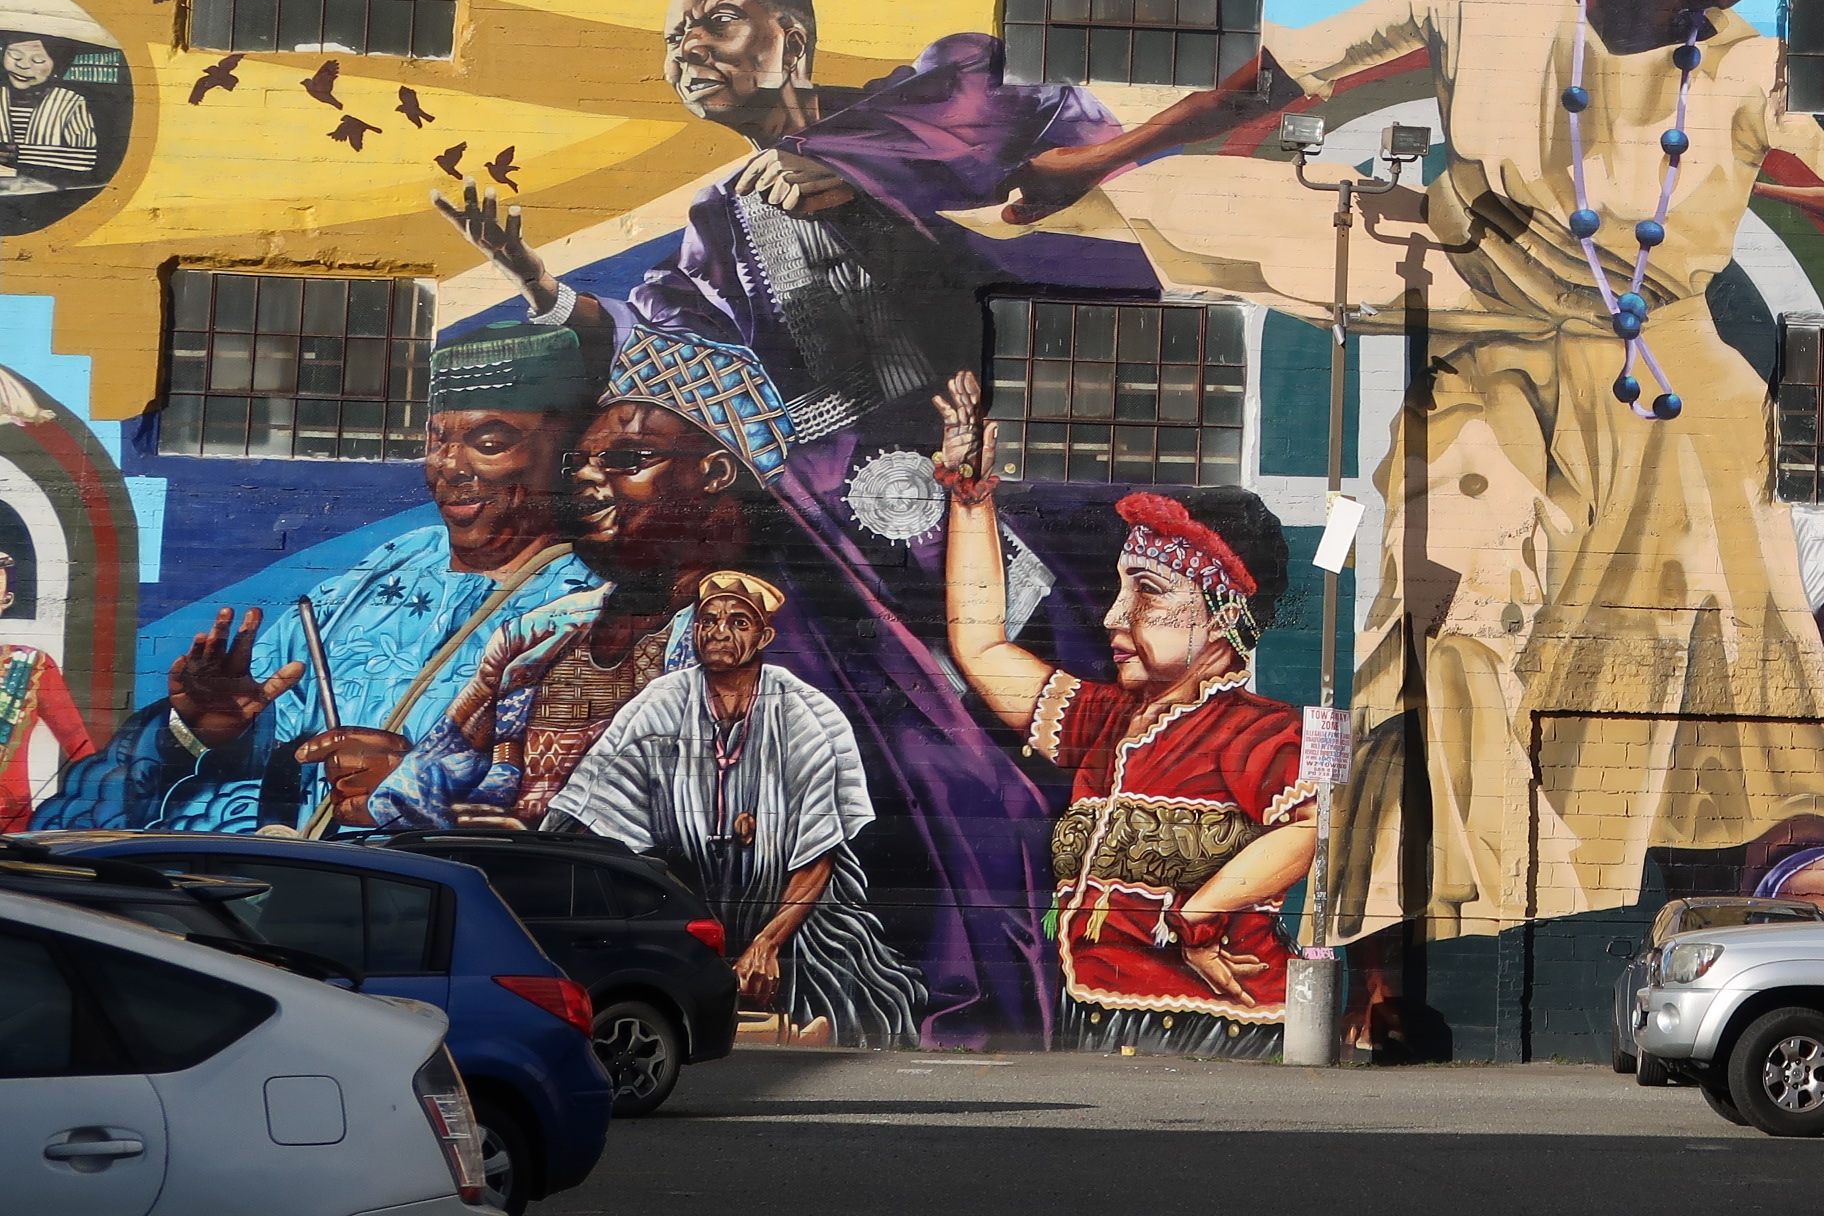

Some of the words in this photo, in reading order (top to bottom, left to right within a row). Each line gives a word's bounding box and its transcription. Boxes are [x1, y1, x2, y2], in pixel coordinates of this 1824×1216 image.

[1311, 709, 1328, 720] TOW
[1330, 711, 1347, 722] AWAY
[1321, 721, 1340, 731] ZONE
